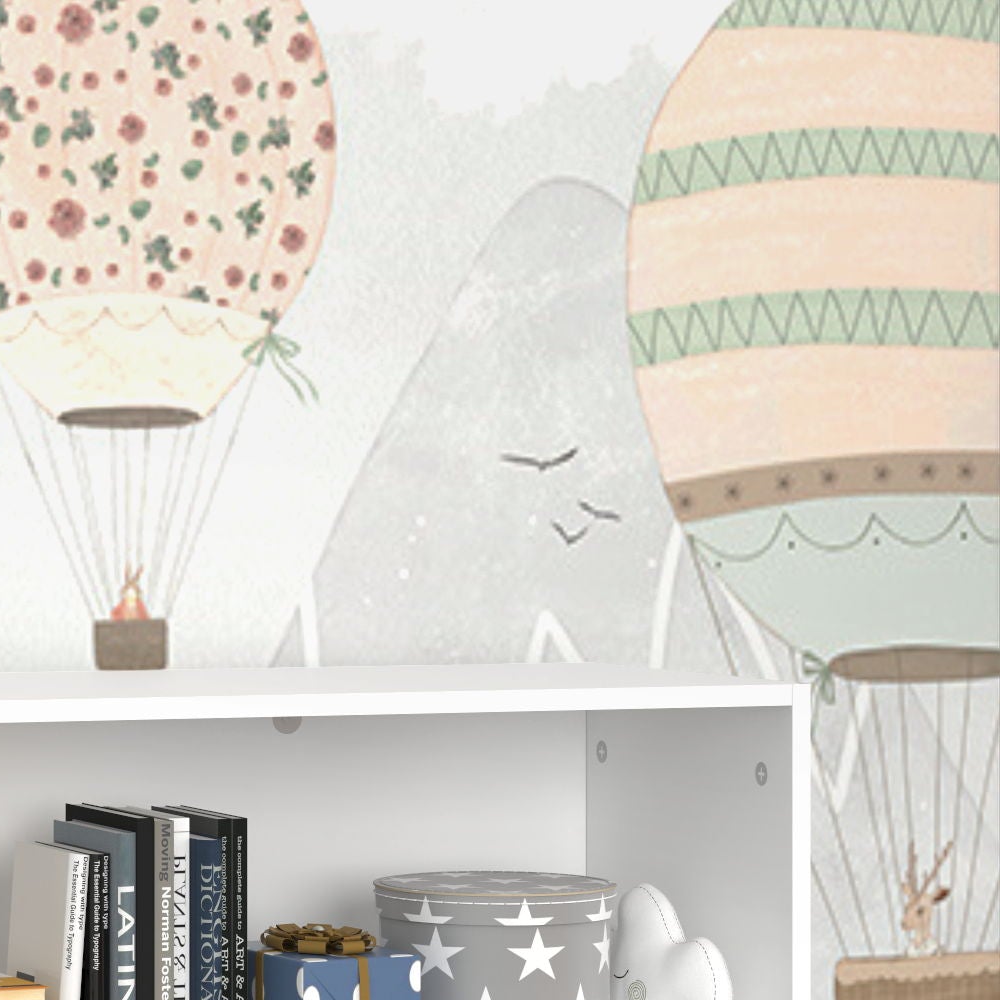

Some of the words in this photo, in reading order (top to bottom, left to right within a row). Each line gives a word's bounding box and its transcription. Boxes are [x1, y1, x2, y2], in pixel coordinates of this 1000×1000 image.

[159, 823, 171, 882] Moving
[72, 860, 80, 872] The
[78, 856, 89, 895] Designing
[70, 874, 79, 902] Essential
[69, 903, 77, 923] Guide
[161, 886, 171, 952] Norman
[235, 895, 243, 919] guide
[68, 924, 75, 932] to
[221, 920, 227, 930] to
[237, 920, 242, 930] to
[65, 933, 75, 970] Typography
[91, 933, 100, 971] Typography
[221, 936, 229, 971] ART
[235, 934, 245, 971] ART
[221, 975, 229, 990] &
[235, 975, 245, 990] &
